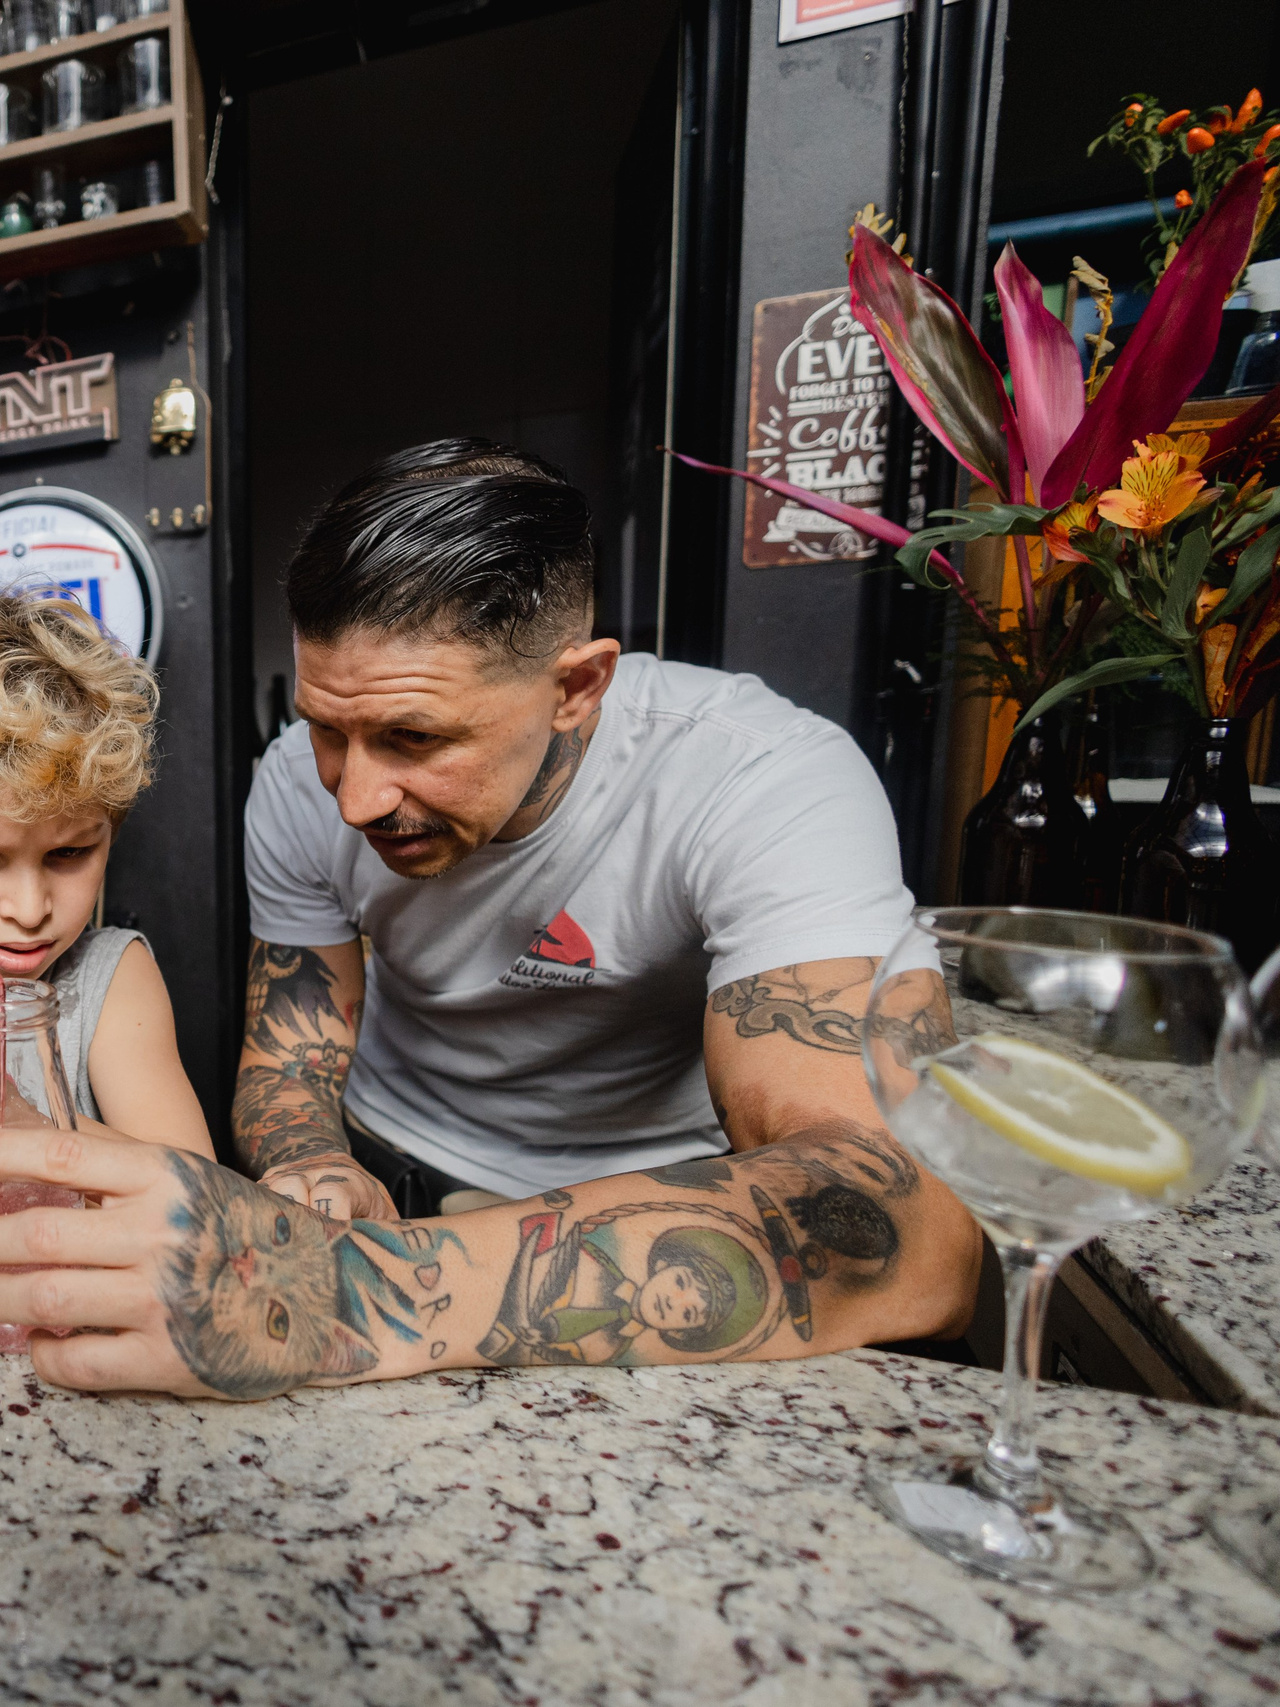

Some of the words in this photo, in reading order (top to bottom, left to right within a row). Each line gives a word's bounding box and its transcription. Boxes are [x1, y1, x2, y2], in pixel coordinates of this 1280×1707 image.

[797, 333, 888, 385] EVE
[789, 380, 850, 402] FORGET
[853, 375, 876, 392] TO
[788, 407, 888, 454] Coff
[786, 454, 888, 491] BLAC
[510, 958, 595, 986] ditional
